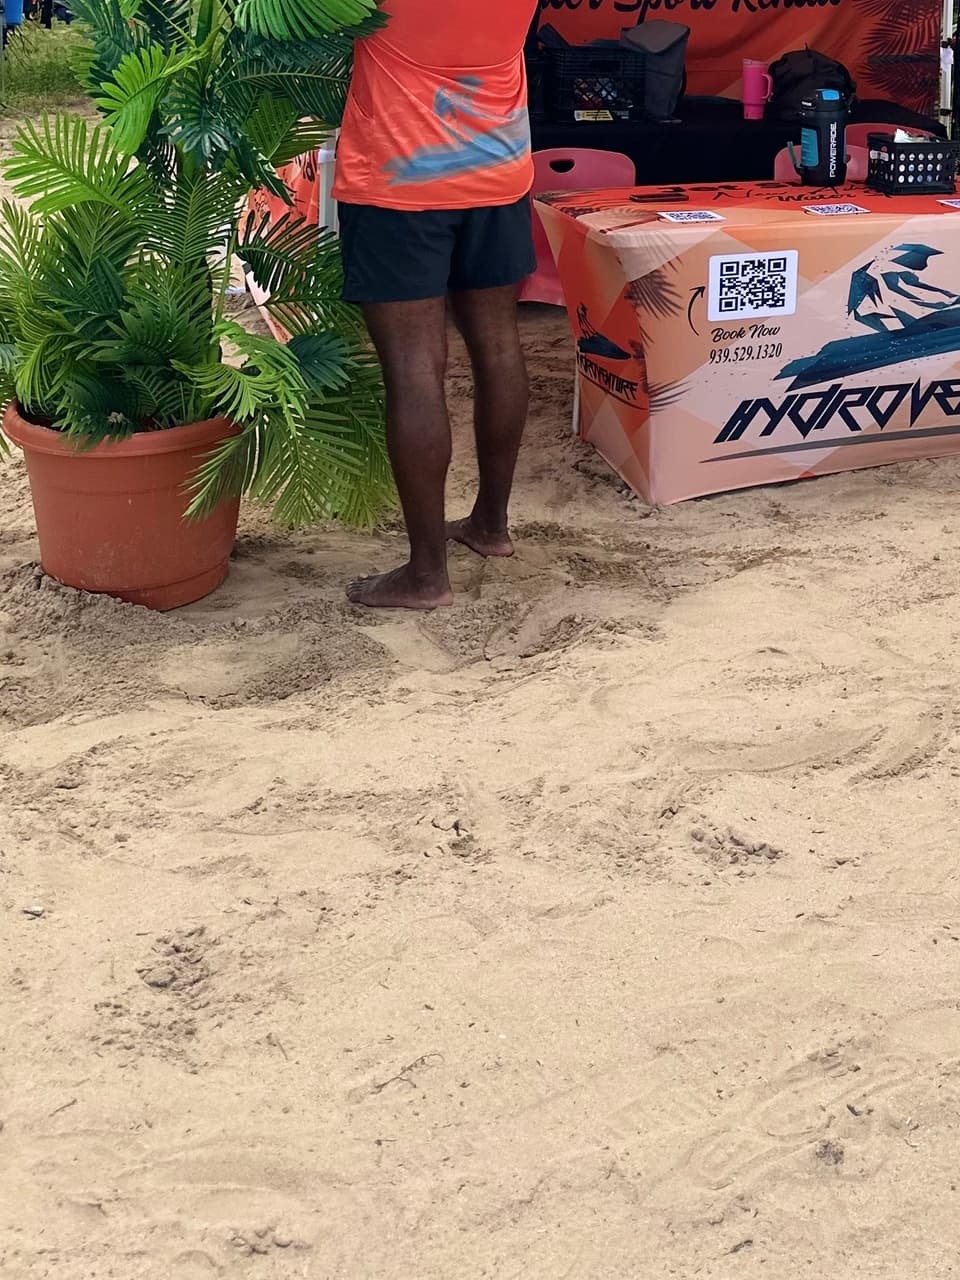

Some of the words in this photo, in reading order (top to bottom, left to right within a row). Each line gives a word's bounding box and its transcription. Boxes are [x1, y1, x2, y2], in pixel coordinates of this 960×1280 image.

[711, 326, 746, 343] Book
[748, 323, 781, 339] Now
[709, 342, 783, 365] 939.529.1320
